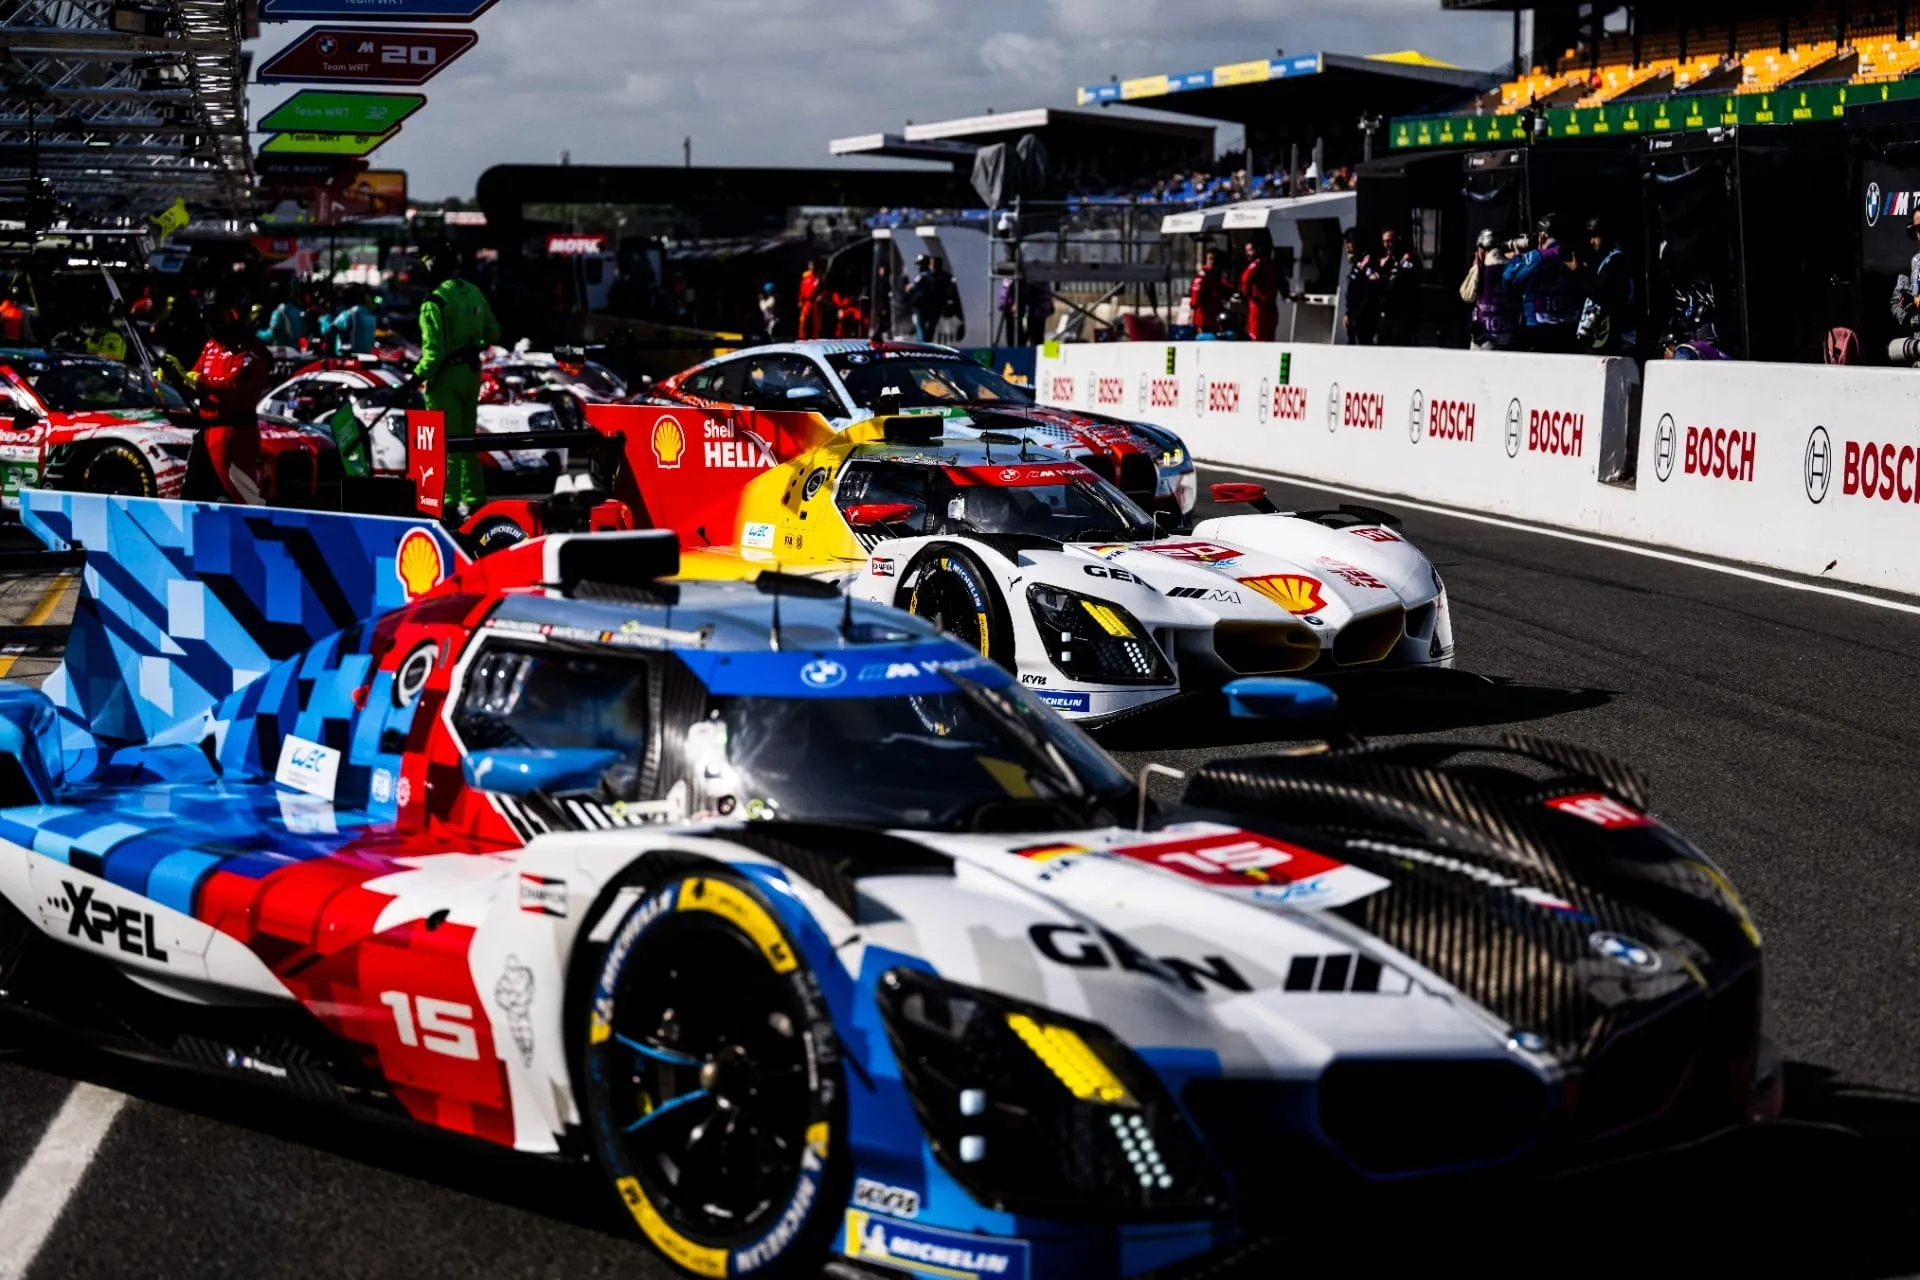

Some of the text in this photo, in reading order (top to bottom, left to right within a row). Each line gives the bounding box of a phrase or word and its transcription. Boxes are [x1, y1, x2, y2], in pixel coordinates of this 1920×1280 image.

[322, 62, 370, 72] Team WRT
[381, 45, 436, 65] 20
[325, 107, 350, 117] WRT
[1151, 379, 1180, 407] BOSCH
[1208, 381, 1241, 413] BOSCH
[1272, 386, 1307, 421] BOSCH
[1343, 391, 1385, 430] BOSCH
[1428, 399, 1476, 441] BOSCH
[417, 425, 435, 451] HY
[703, 420, 735, 439] Shell
[1528, 409, 1584, 456] BOSCH
[704, 441, 779, 468] HELIX
[1684, 426, 1757, 481] BOSCH
[3, 466, 39, 492] 32
[951, 562, 983, 608] MICHELIN
[1159, 840, 1293, 874] 15
[62, 881, 168, 962] XPEL
[601, 888, 674, 994] MICHELIN
[380, 990, 480, 1060] 15
[890, 1236, 1009, 1274] MICHELIN
